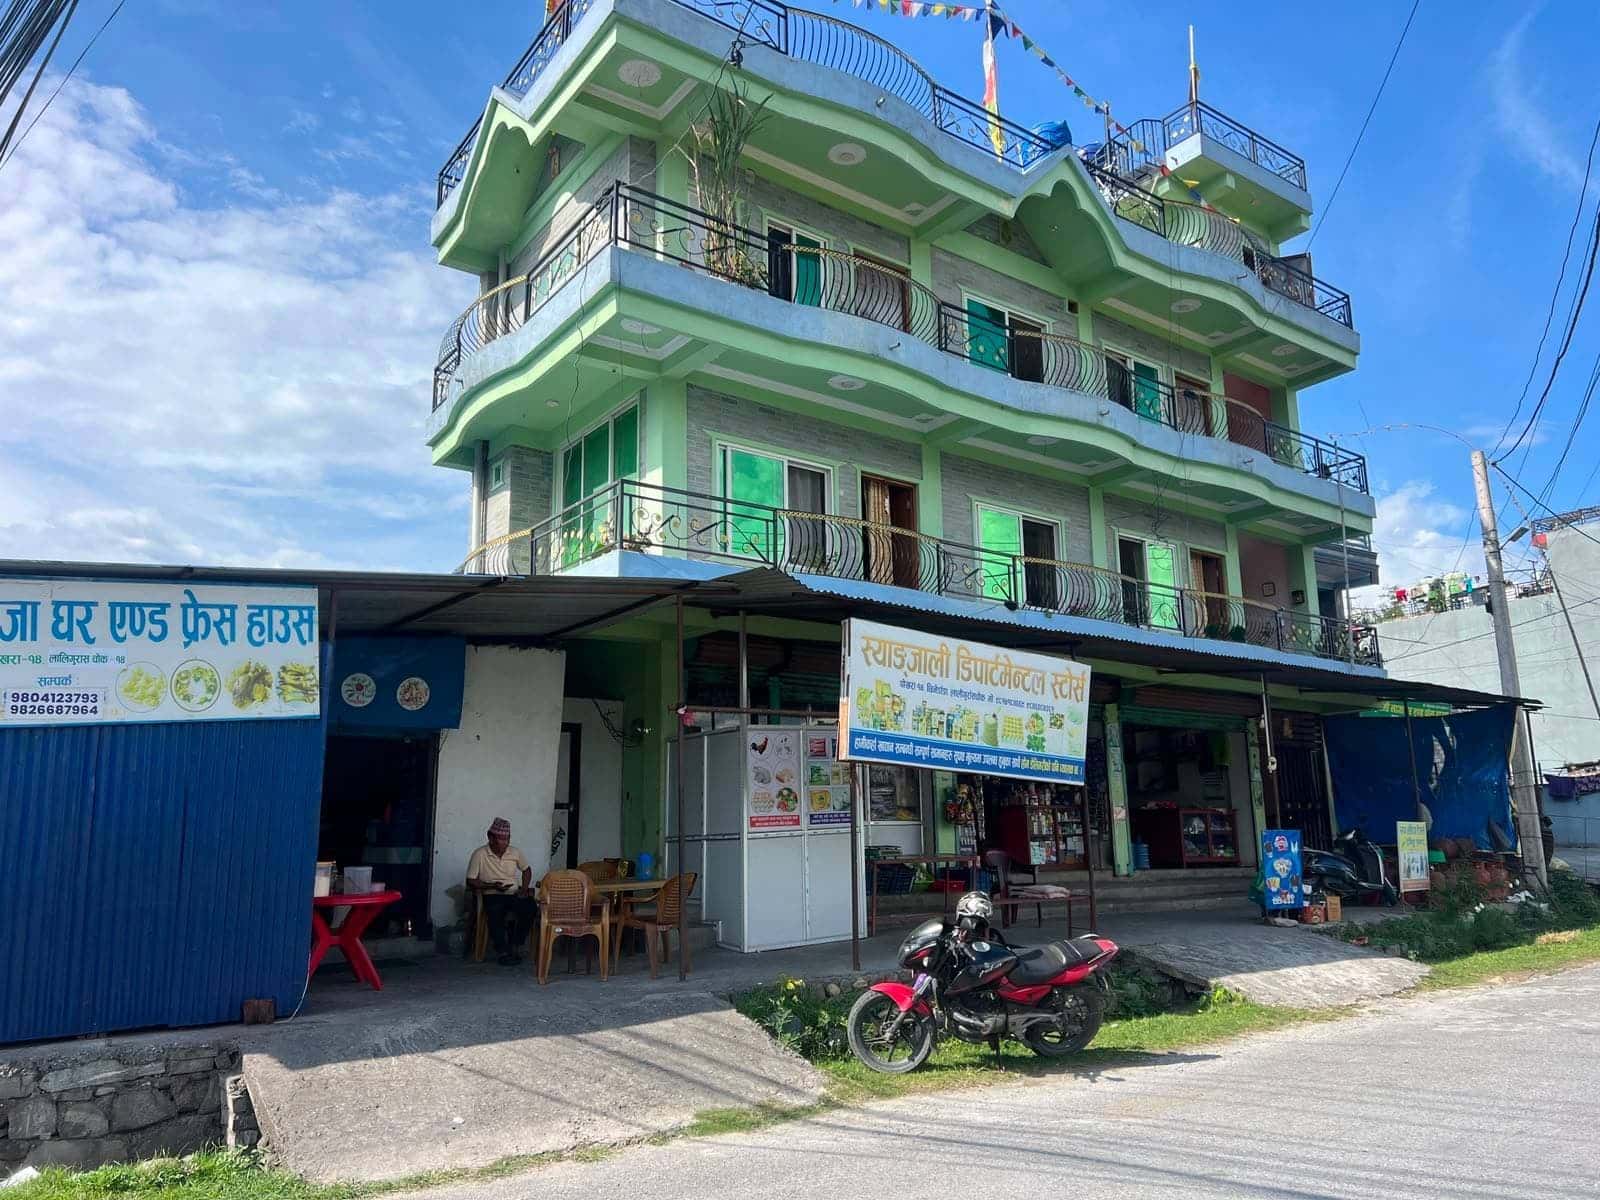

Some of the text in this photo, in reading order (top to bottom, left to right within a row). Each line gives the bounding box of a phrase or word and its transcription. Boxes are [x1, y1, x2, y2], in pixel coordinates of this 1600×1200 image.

[0, 588, 316, 649] जा घर एण्ड फ्रेस हाउस
[956, 645, 1046, 696] डिपार्टमेन्टल
[1051, 667, 1087, 703] स्टोर्स
[10, 705, 98, 715] 9826687964
[11, 692, 98, 703] 9804123793
